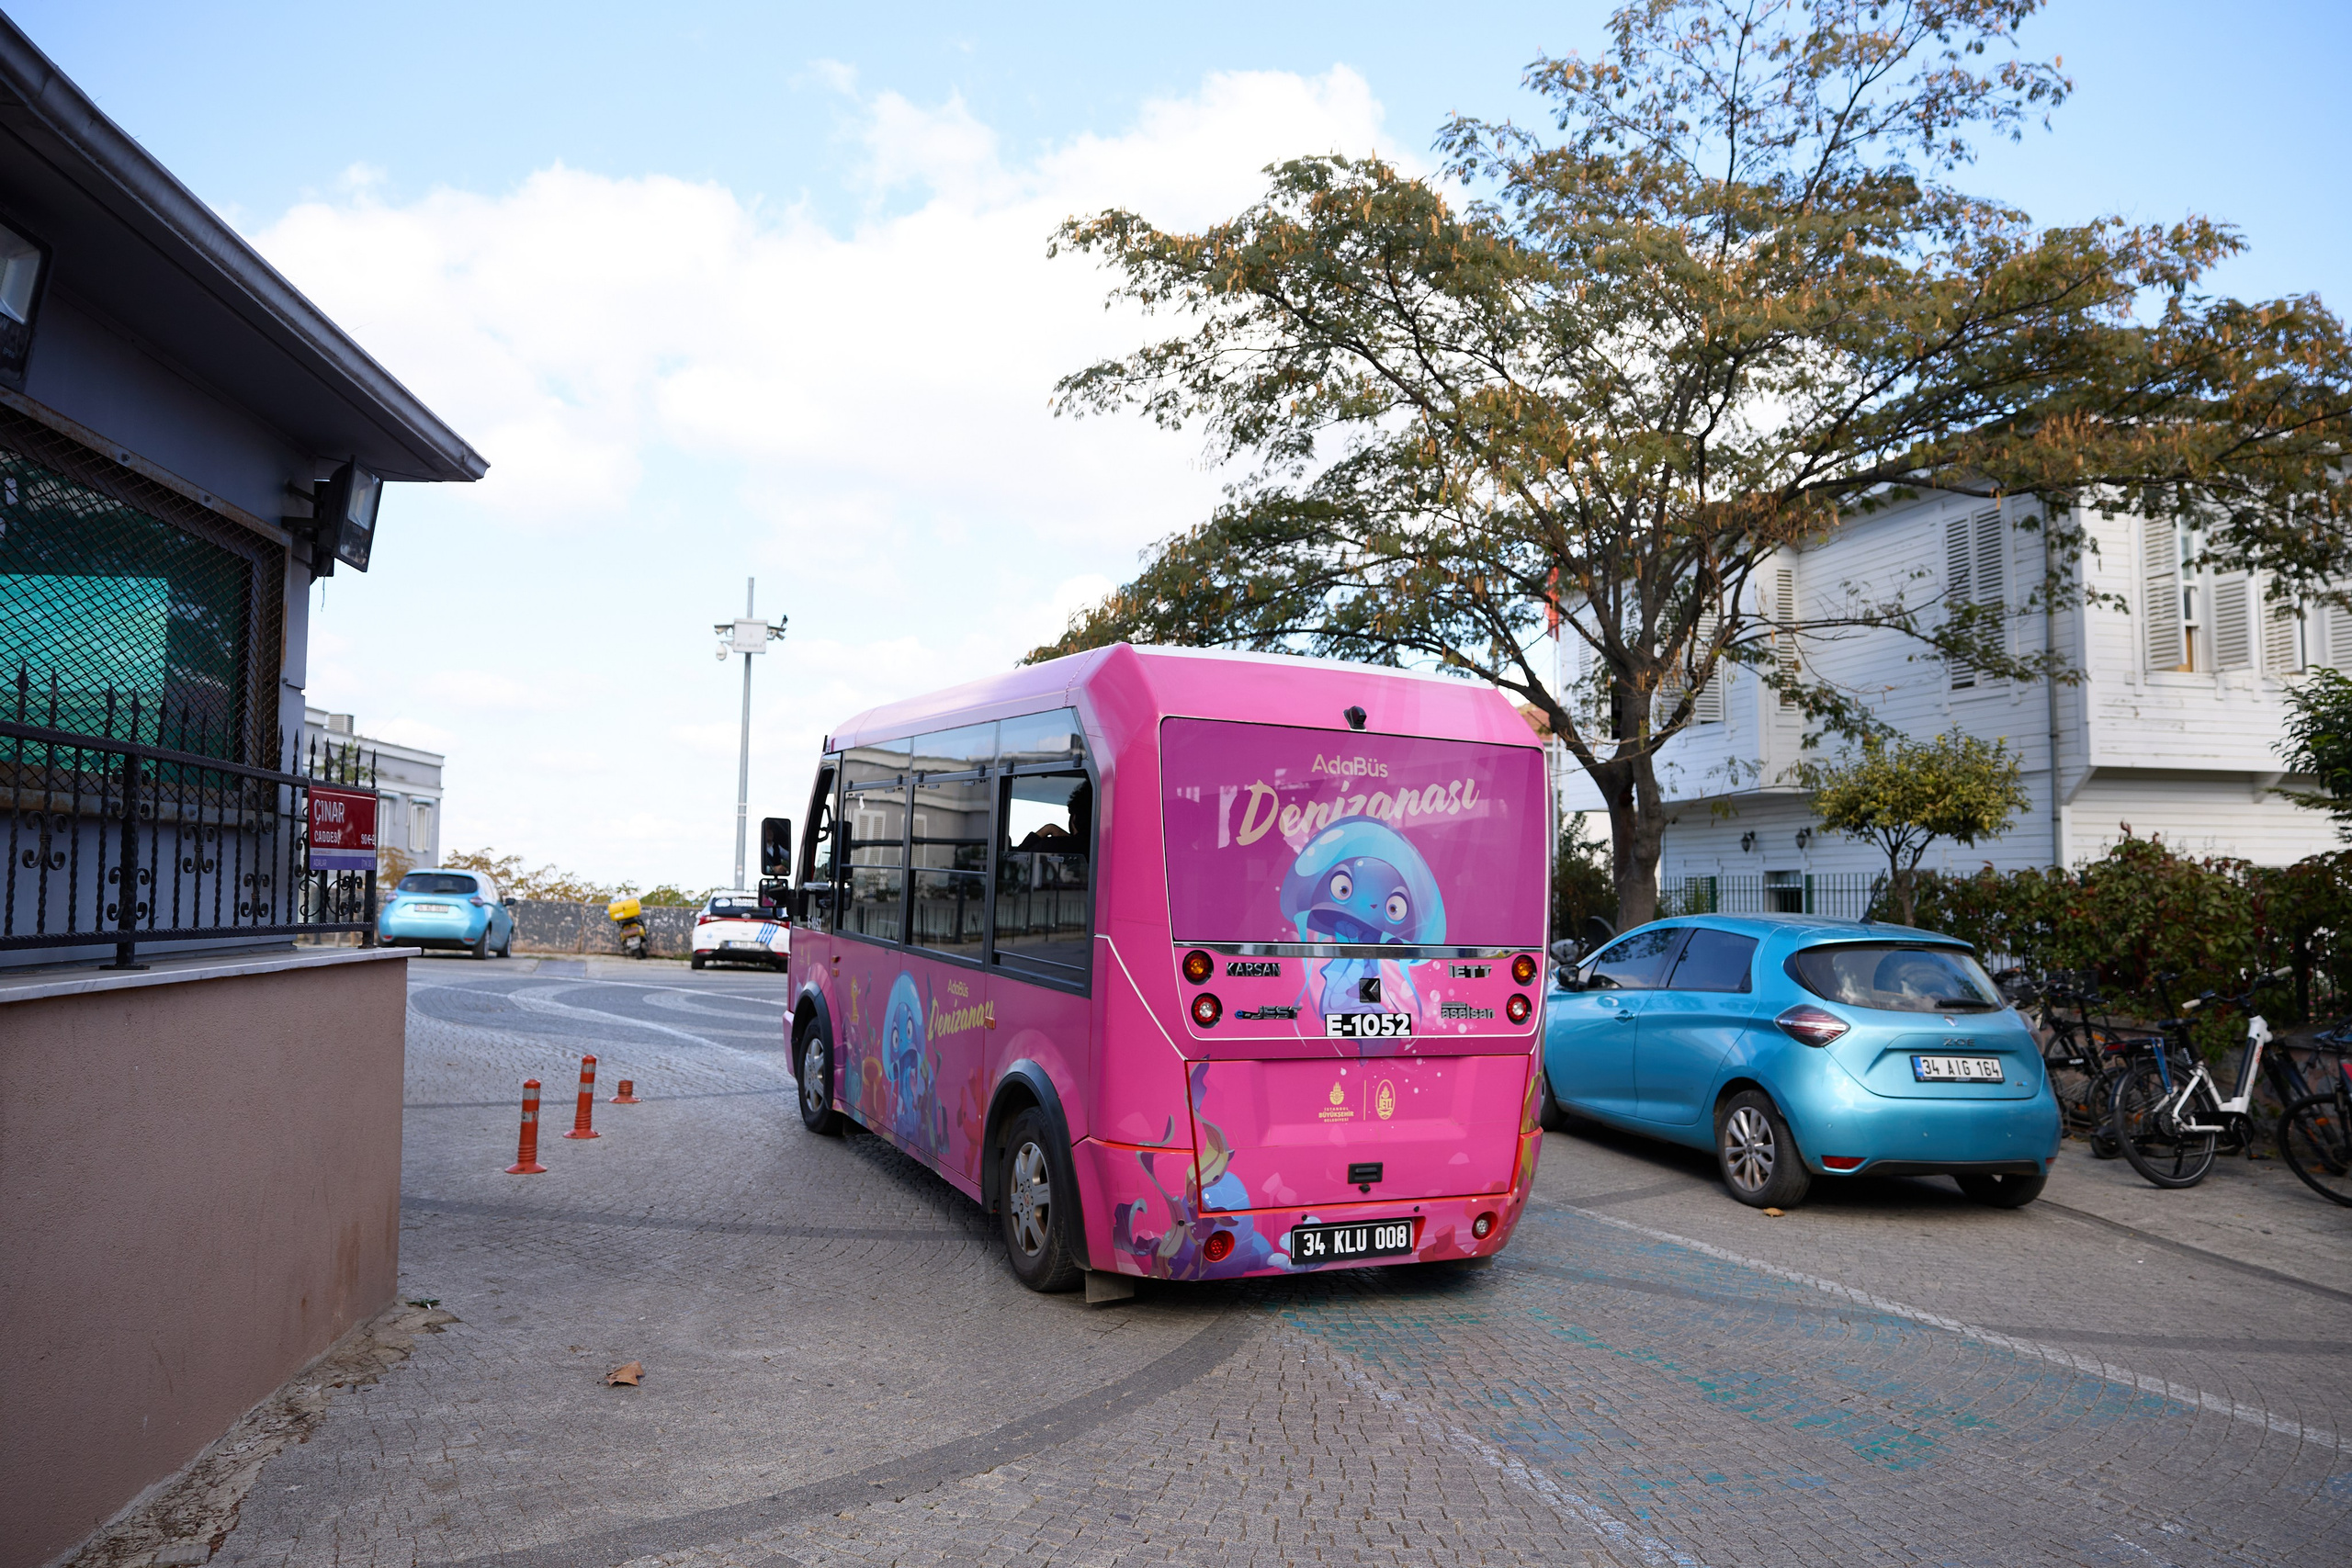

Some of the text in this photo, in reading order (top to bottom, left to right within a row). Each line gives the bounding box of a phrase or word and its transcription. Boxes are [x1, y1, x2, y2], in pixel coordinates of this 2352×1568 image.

[1311, 753, 1388, 778] AdaBüs
[313, 799, 345, 825] ÇINAR
[1235, 778, 1480, 846] Denizanası
[1226, 962, 1281, 977] KARSAN
[1448, 960, 1492, 978] İETT
[947, 978, 968, 998] AdaBüs
[1235, 1005, 1303, 1021] e-JEST
[1442, 1004, 1495, 1019] aselsan
[1326, 1013, 1410, 1037] E-1052
[1943, 1037, 1976, 1046] ZOE
[1922, 1059, 1939, 1075] 34
[1947, 1059, 1971, 1076] AIG
[1976, 1061, 2000, 1077] 164
[1303, 1224, 1408, 1257] 34 KLU 008
